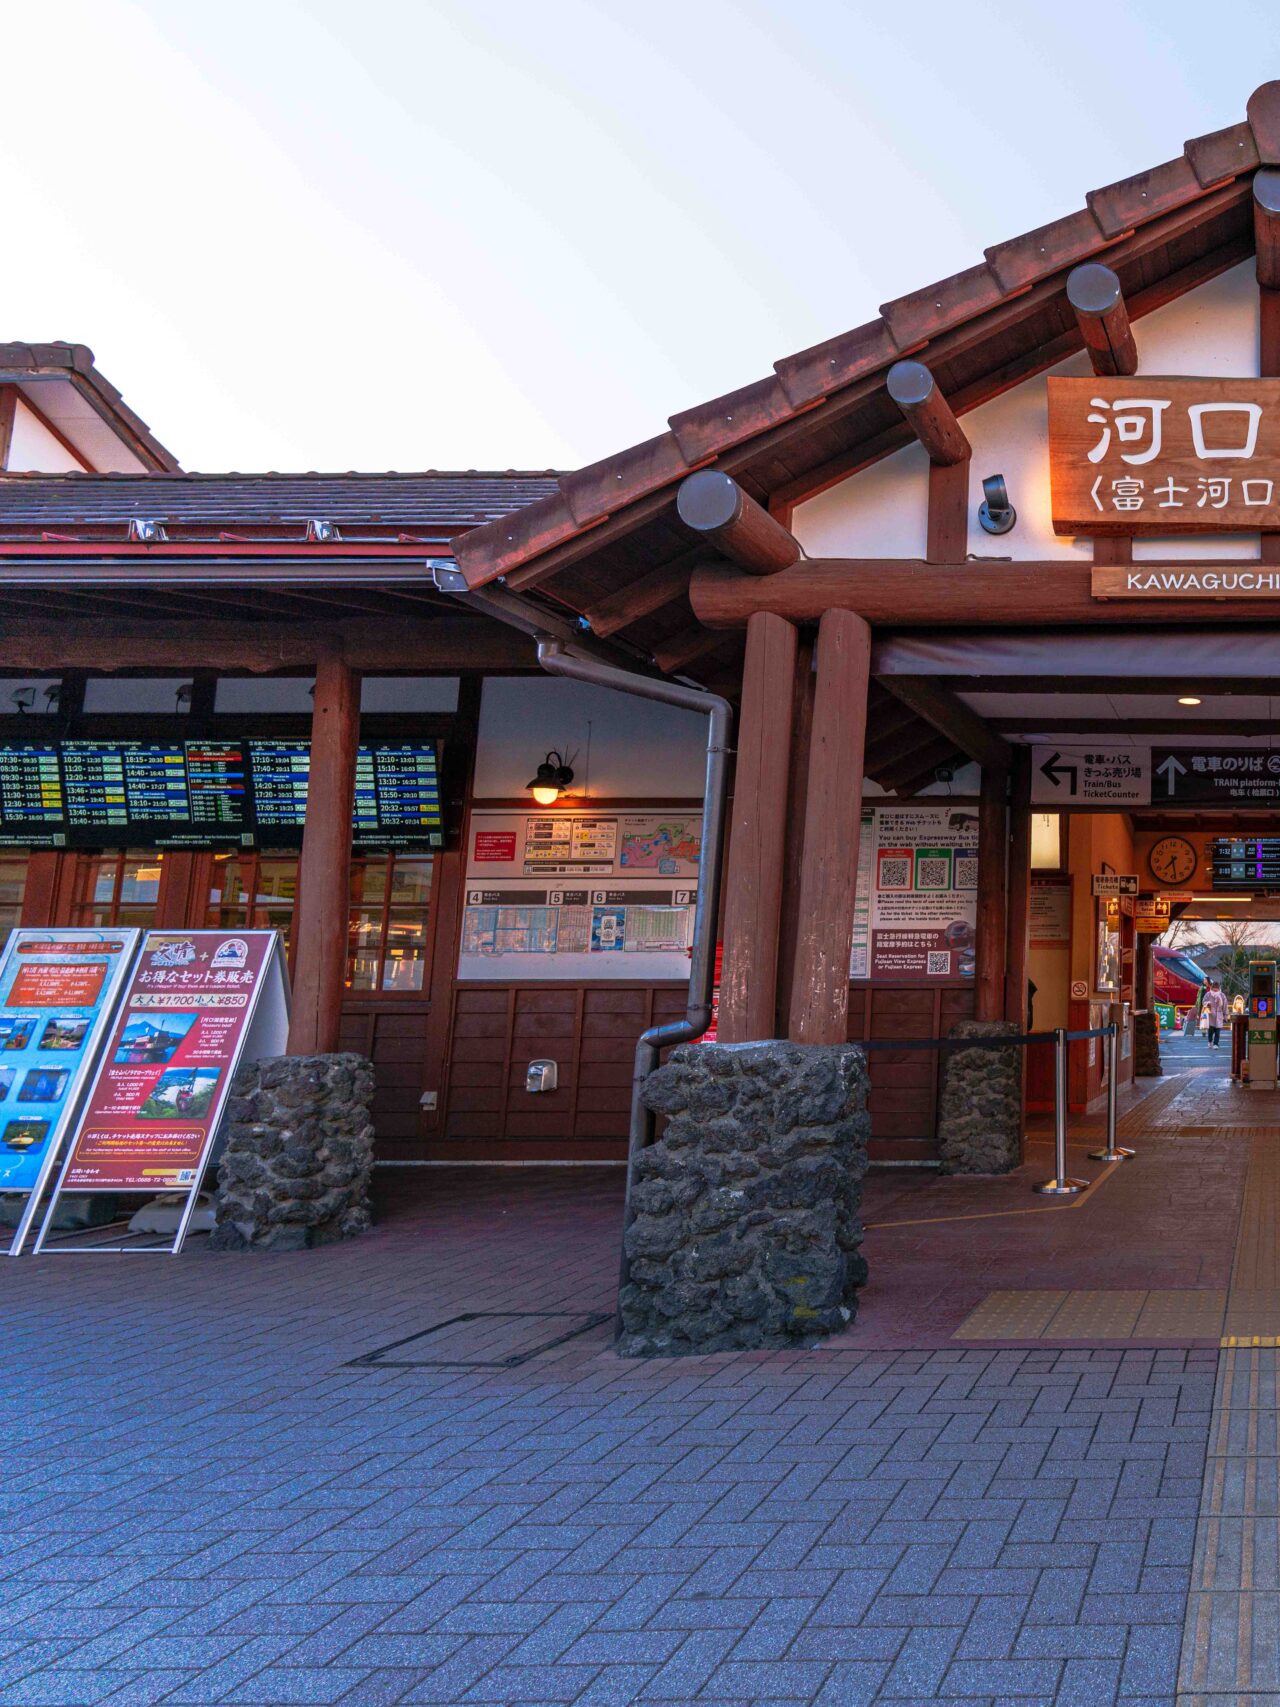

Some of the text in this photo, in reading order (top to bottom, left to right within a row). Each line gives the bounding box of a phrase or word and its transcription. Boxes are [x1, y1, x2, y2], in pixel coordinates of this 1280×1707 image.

[1084, 754, 1132, 765] 電車・バス
[1191, 756, 1264, 772] 電車のりば
[1083, 780, 1122, 788] Train/Bus
[1214, 778, 1239, 787] TRAIN
[1083, 790, 1140, 798] TicketCounter
[472, 893, 479, 902] 4
[553, 892, 560, 902] 5
[596, 893, 603, 902] 6
[680, 893, 687, 902] 7
[139, 970, 254, 984] お得なセット券販売
[135, 996, 156, 1004] 大人
[195, 996, 216, 1004] 小人
[217, 996, 245, 1005] ¥850
[1160, 1015, 1167, 1025] 2
